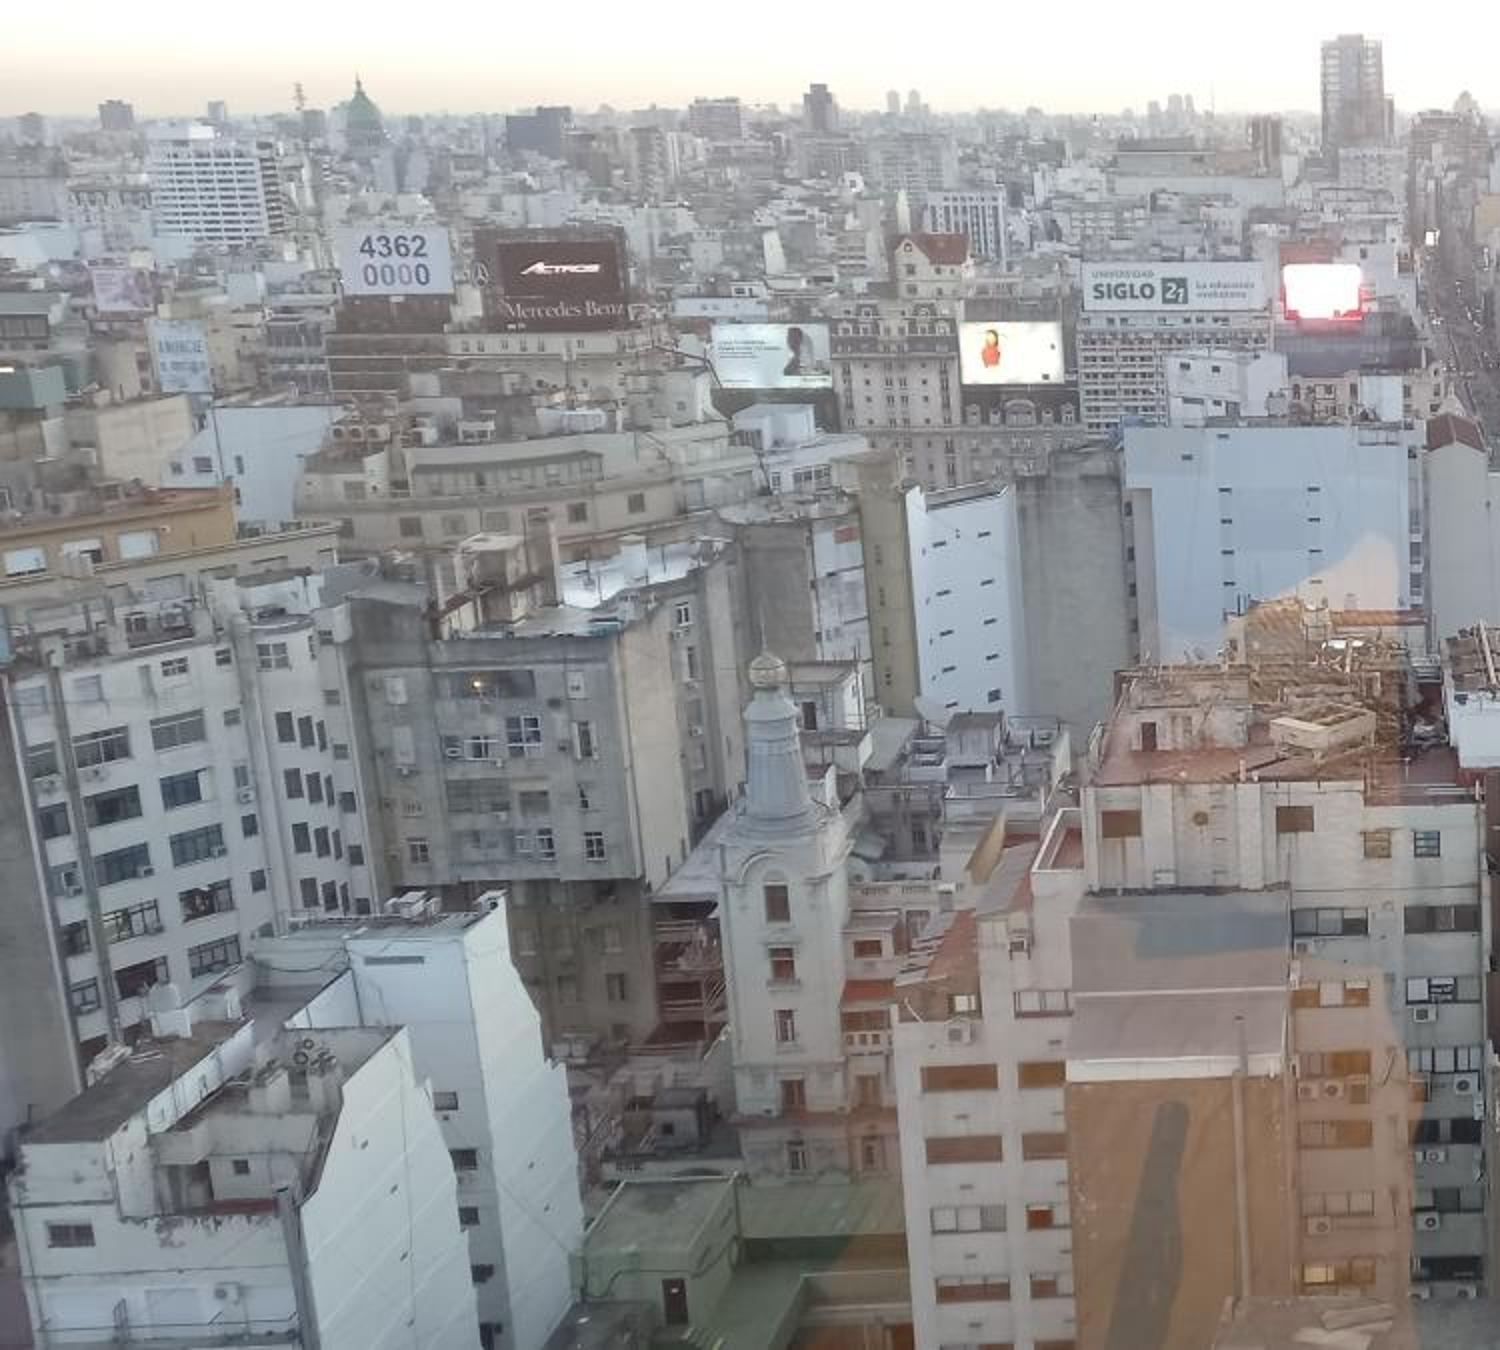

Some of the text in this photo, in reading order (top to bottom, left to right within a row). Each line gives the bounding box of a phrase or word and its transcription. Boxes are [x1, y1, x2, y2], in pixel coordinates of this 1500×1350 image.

[360, 235, 428, 258] 4362
[364, 263, 430, 286] 0000
[1093, 283, 1155, 300] SIGLO
[1166, 282, 1184, 303] 21
